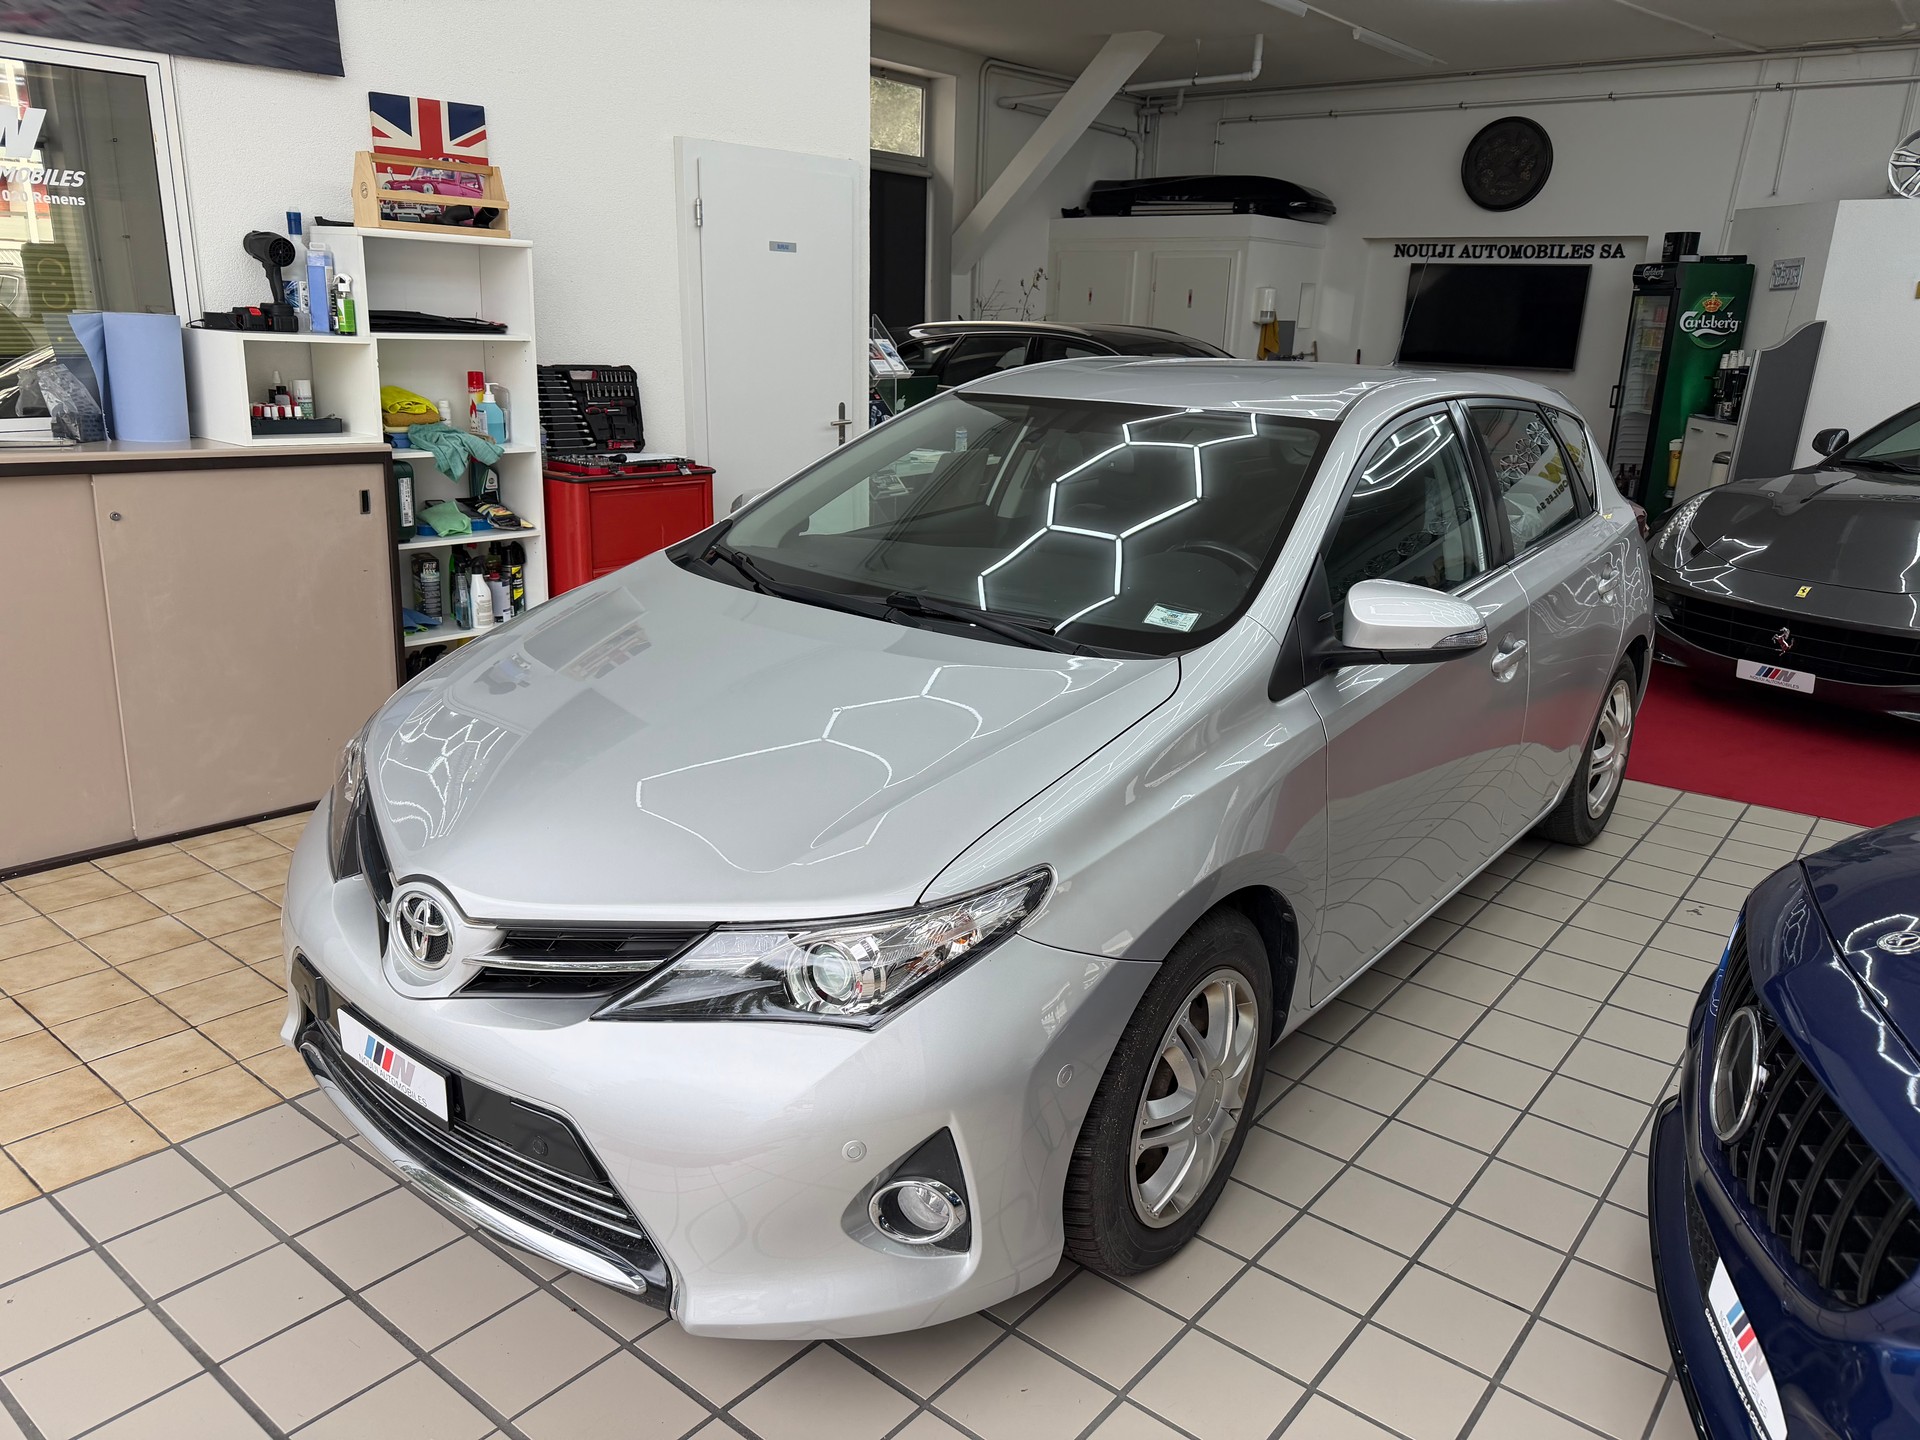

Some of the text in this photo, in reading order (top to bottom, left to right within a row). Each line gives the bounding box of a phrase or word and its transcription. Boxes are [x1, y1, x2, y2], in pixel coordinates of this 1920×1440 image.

[33, 191, 86, 205] Renens
[1394, 243, 1626, 259] NOUIJI AUTOMOBILES SA
[1642, 265, 1665, 278] Carlsberg
[1679, 311, 1740, 334] Carlsberg
[379, 1069, 428, 1108] AUTOMOBILES
